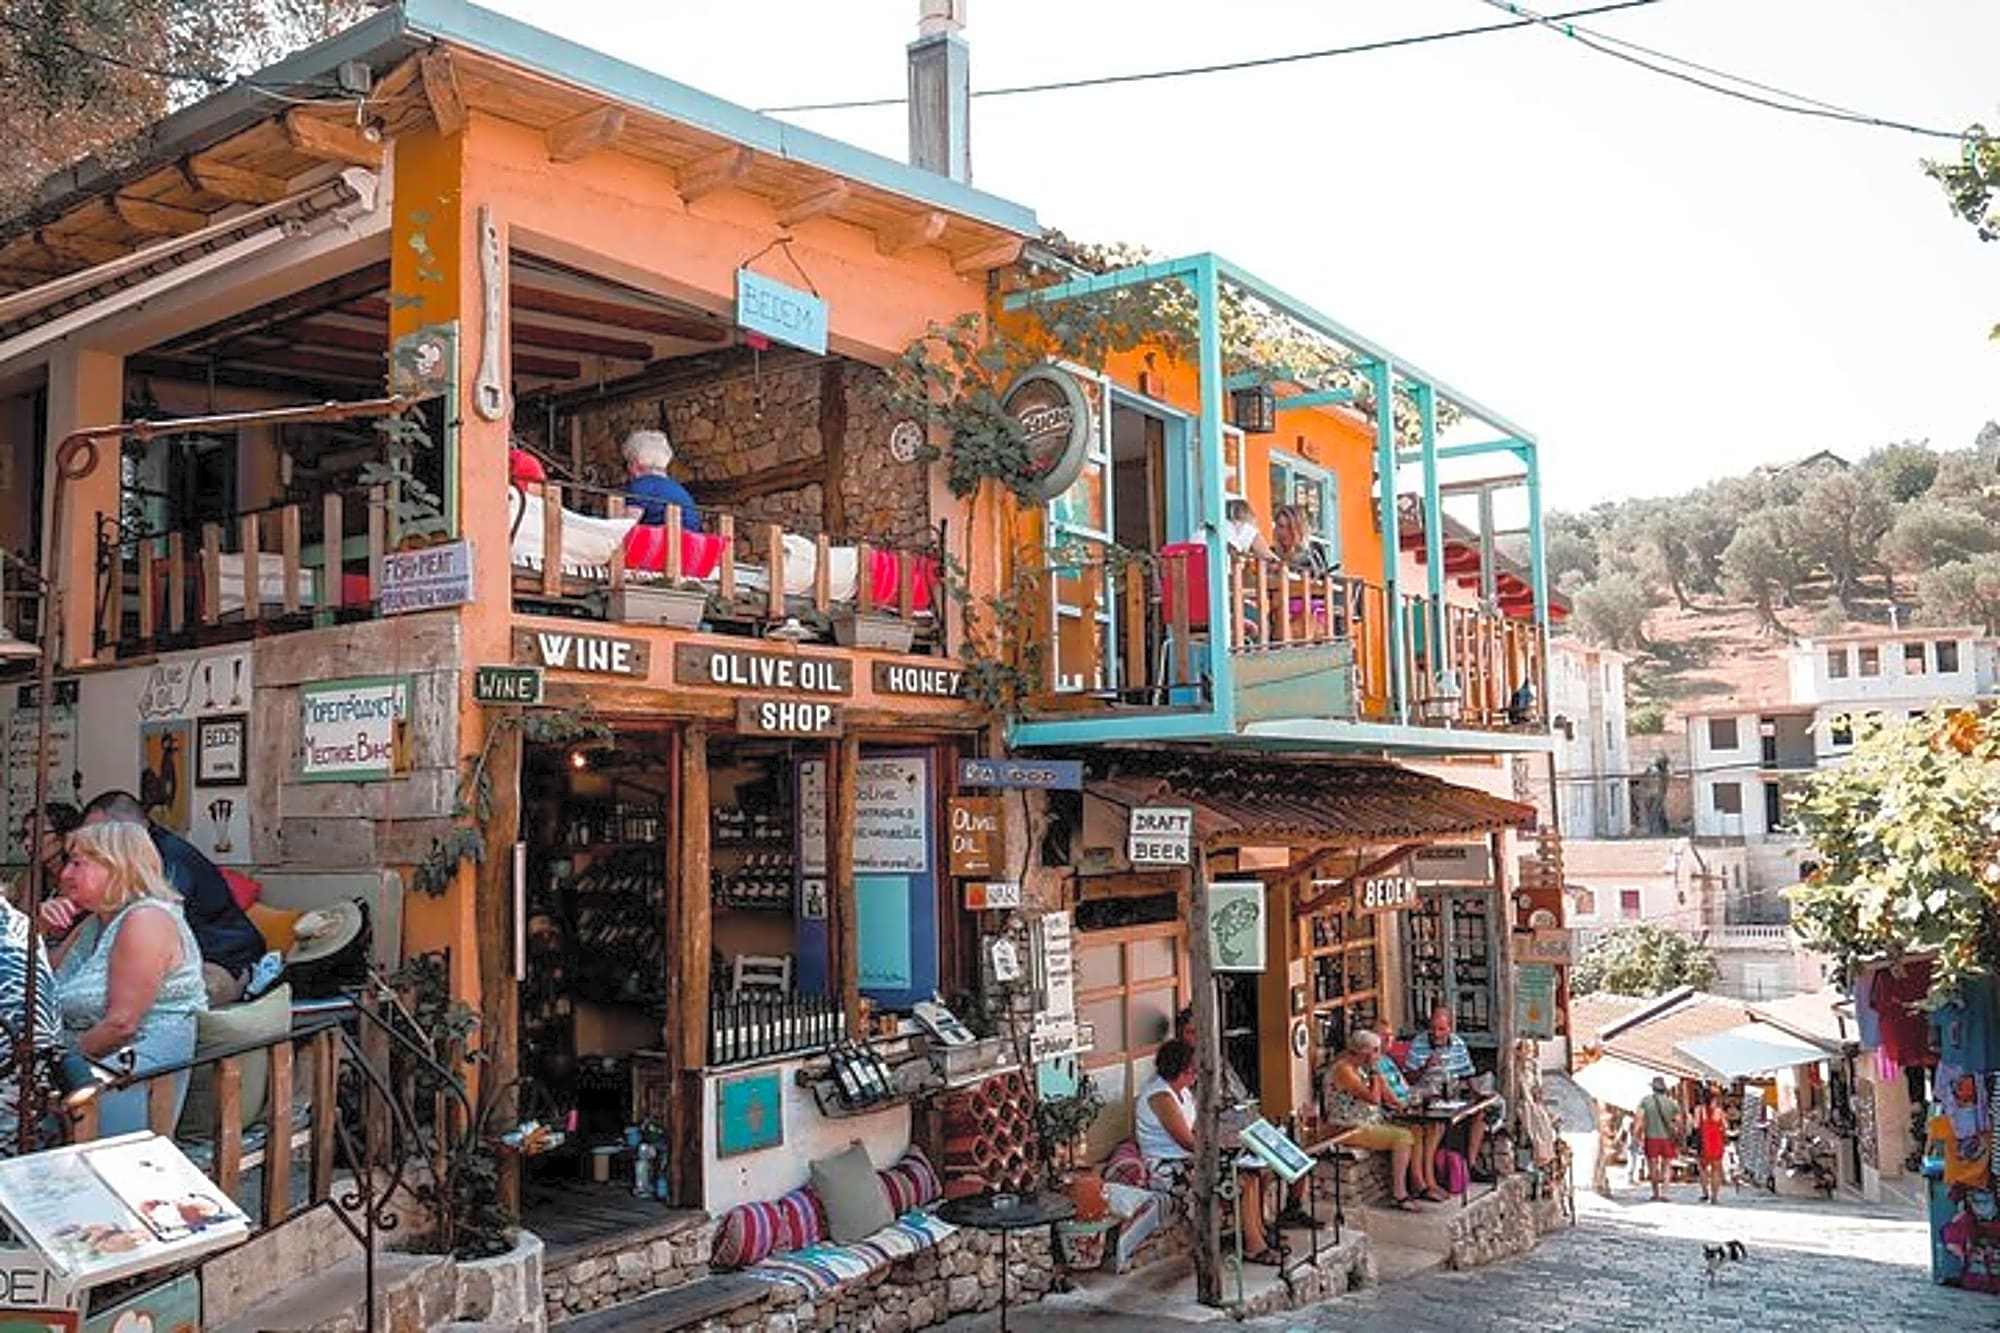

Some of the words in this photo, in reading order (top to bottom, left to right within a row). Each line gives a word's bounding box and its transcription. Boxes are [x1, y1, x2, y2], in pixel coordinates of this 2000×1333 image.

[538, 633, 632, 672] WINE
[710, 652, 792, 688] OLIVE
[799, 660, 841, 691] OIL
[479, 673, 533, 700] WINE
[760, 702, 832, 732] SHOP
[1135, 814, 1189, 832] DRAFT
[1134, 842, 1187, 861] BEER
